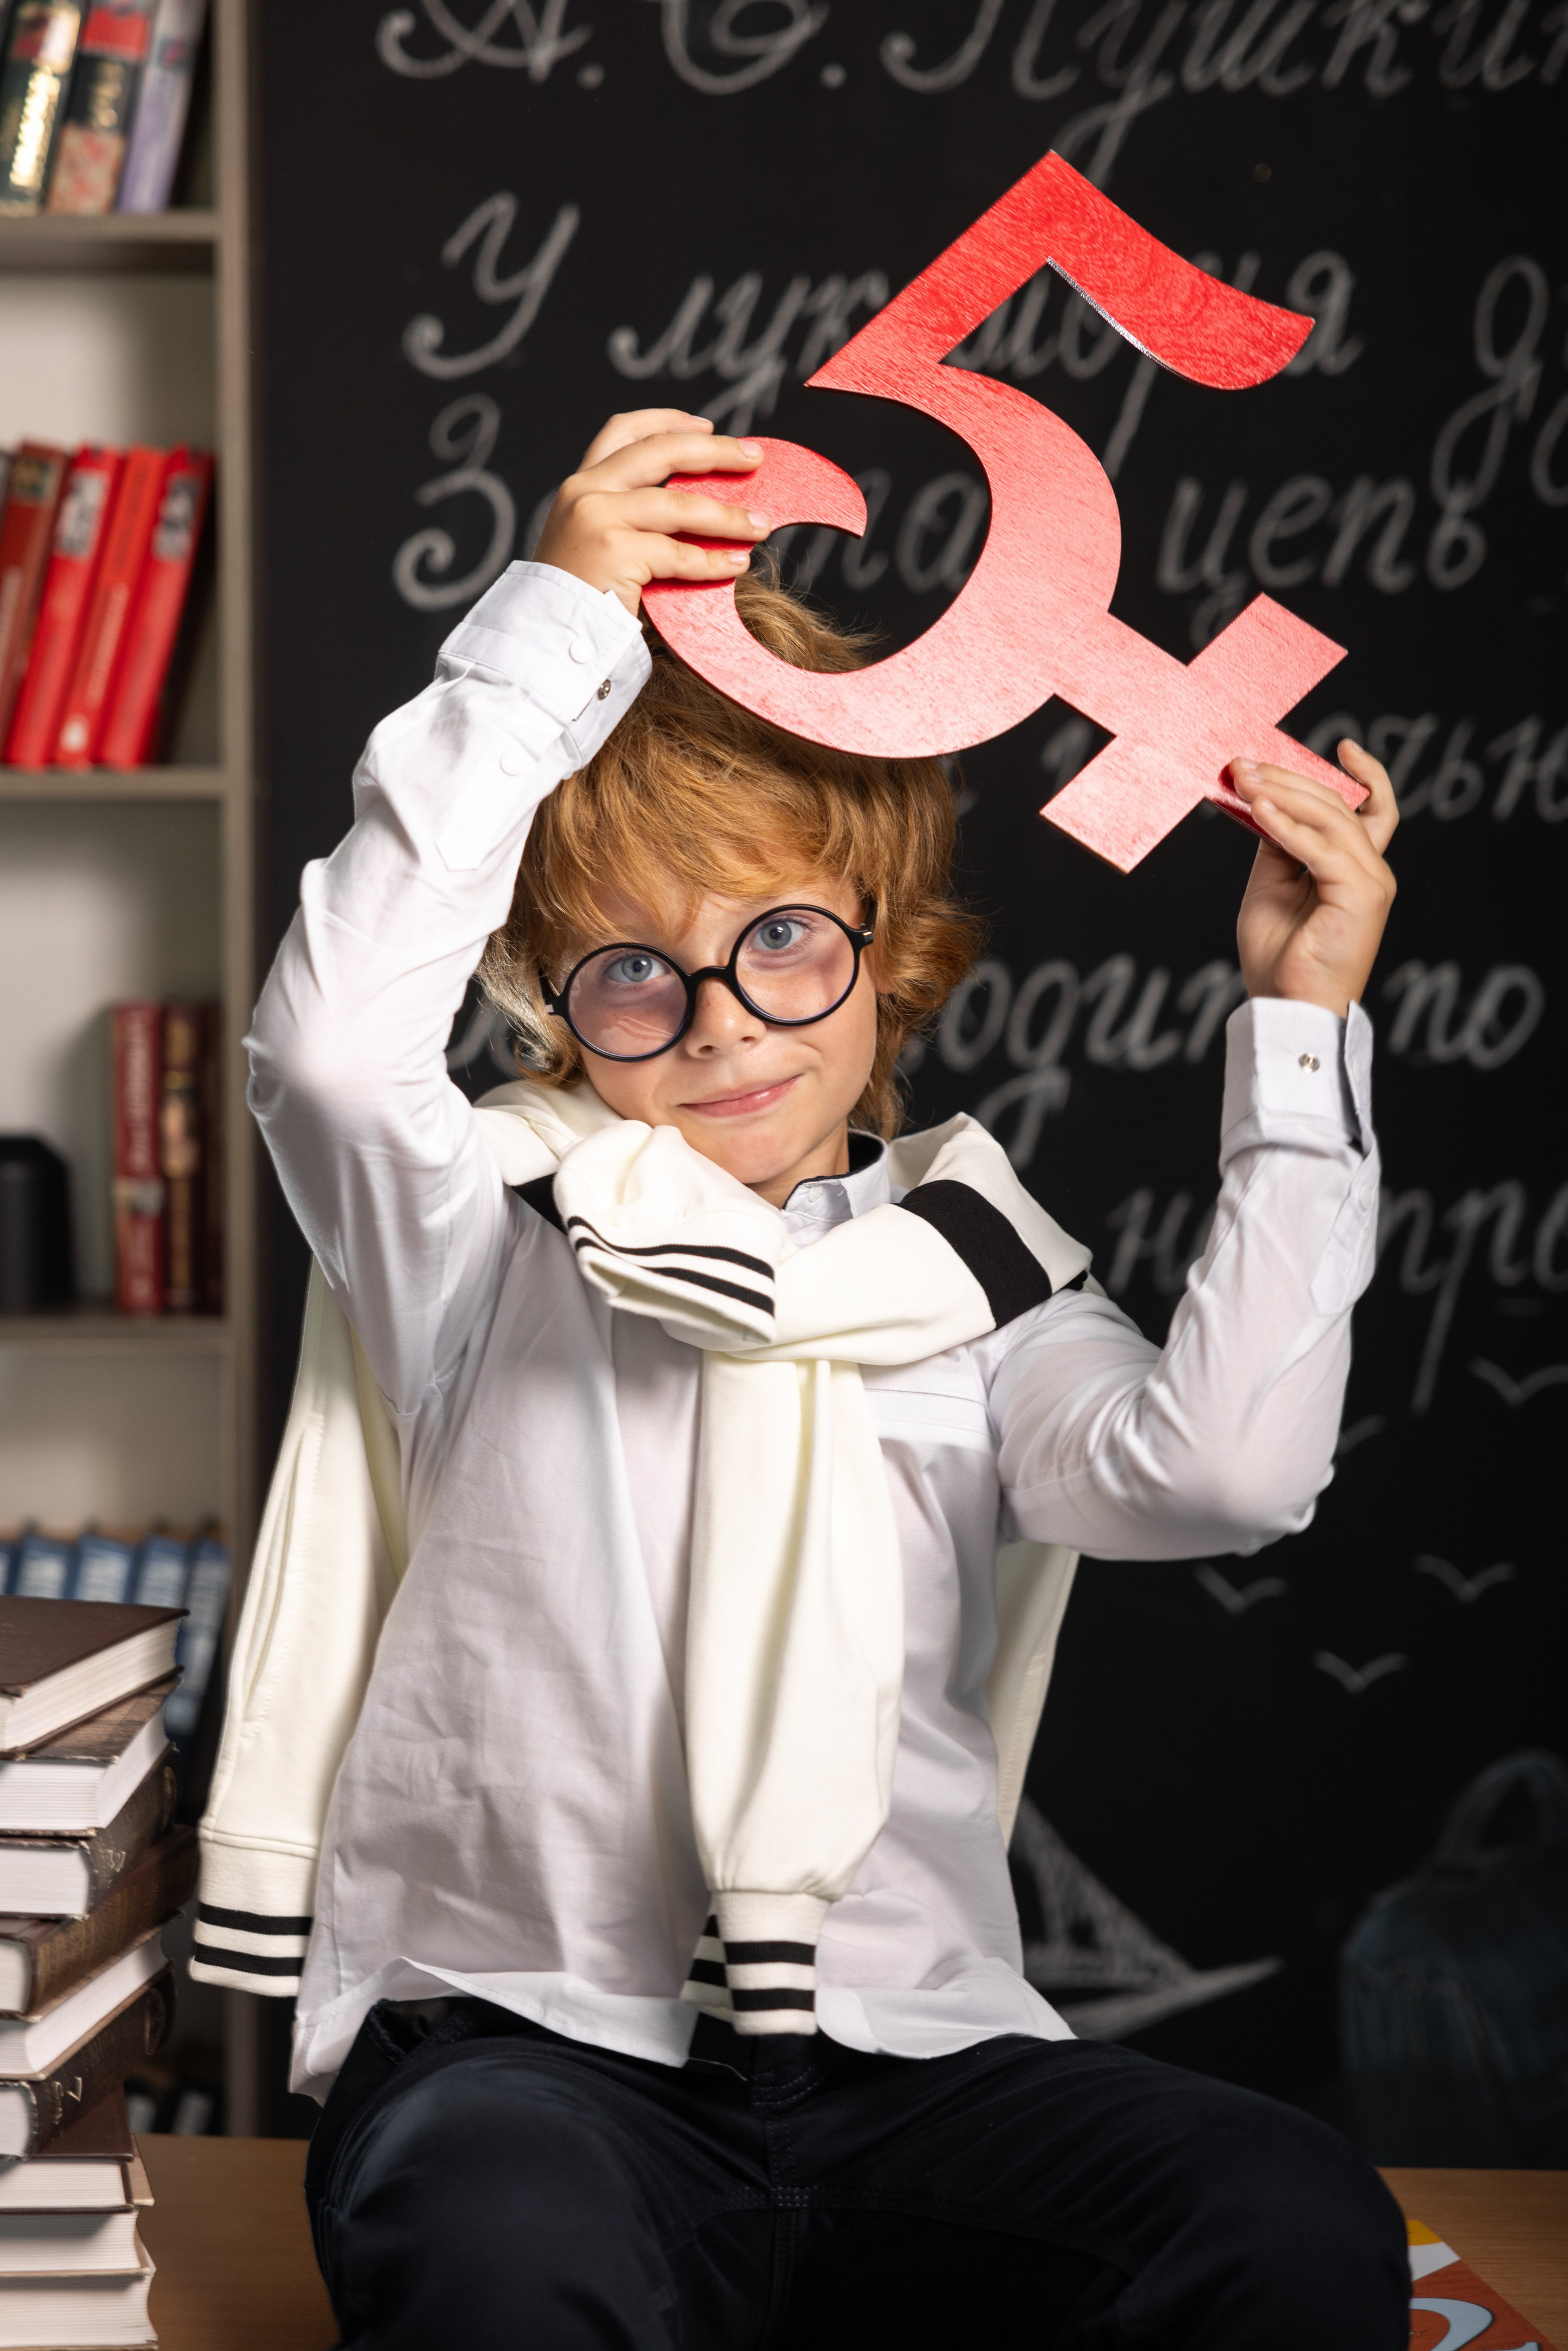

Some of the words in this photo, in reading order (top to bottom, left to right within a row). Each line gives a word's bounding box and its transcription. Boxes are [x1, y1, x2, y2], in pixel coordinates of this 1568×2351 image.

[401, 190, 581, 381] У
[1155, 470, 1488, 653] цепь
[902, 951, 1246, 1171] оди
[1379, 957, 1547, 1072] по
